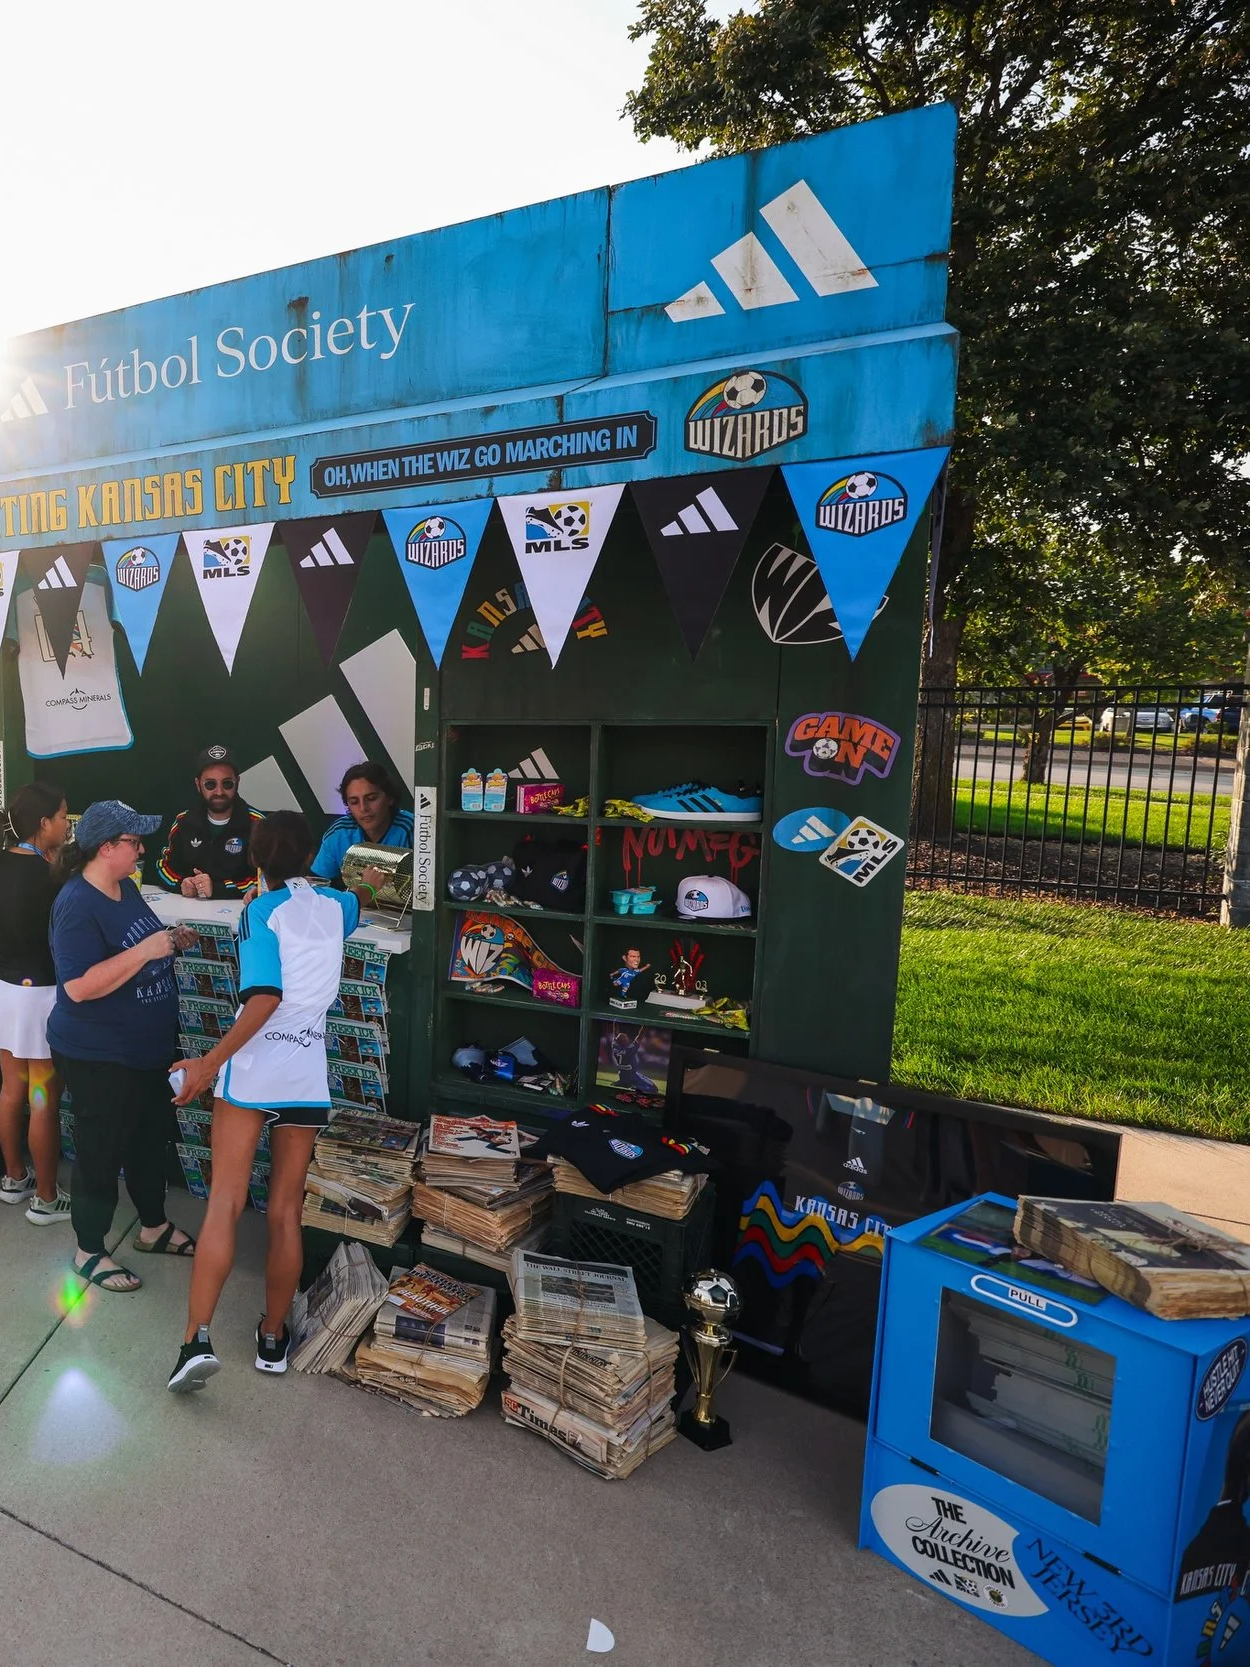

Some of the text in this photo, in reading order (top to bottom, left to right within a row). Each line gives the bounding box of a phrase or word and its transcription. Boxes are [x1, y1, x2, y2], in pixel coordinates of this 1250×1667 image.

[63, 302, 416, 411] Fútbol Society
[689, 406, 804, 458] WIZARDS
[402, 453, 433, 477] THE
[436, 448, 470, 473] WIZ
[474, 445, 501, 467] GO
[505, 429, 611, 464] MARCHING
[616, 425, 637, 449] IN
[77, 468, 202, 529] KANSAS
[213, 455, 297, 512] CITY
[819, 498, 905, 534] WIZARDS
[407, 538, 465, 568] WIZARDS
[525, 537, 589, 554] MLS
[117, 566, 159, 590] WIZARDS
[203, 566, 250, 579] MLS
[46, 694, 111, 707] COMPASS MINERALS
[794, 716, 895, 761] GAME
[547, 787, 560, 800] CAPS
[415, 815, 431, 904] Fútbol Society
[853, 839, 898, 883] MLS
[460, 936, 504, 974] WIZ
[655, 973, 707, 990] 20 03
[843, 1162, 868, 1174] adidas
[794, 1195, 859, 1230] KANSAS
[543, 1265, 562, 1273] WALL
[593, 1273, 625, 1281] JOURNAL
[398, 1289, 450, 1315] BEAUTIFUL
[1010, 1289, 1044, 1309] PULL
[1203, 1345, 1238, 1399] HUSTLE HIT
[1205, 1360, 1239, 1413] NEVER QUIT
[518, 1404, 566, 1440] Times
[931, 1497, 967, 1524] THE
[905, 1516, 1010, 1563] Archive
[911, 1536, 1015, 1589] COLLECTION
[1180, 1563, 1237, 1596] KANSAS CITY
[956, 1586, 980, 1598] MLS
[1027, 1538, 1153, 1656] NEW 3RD
[1031, 1567, 1126, 1653] JERSEY
